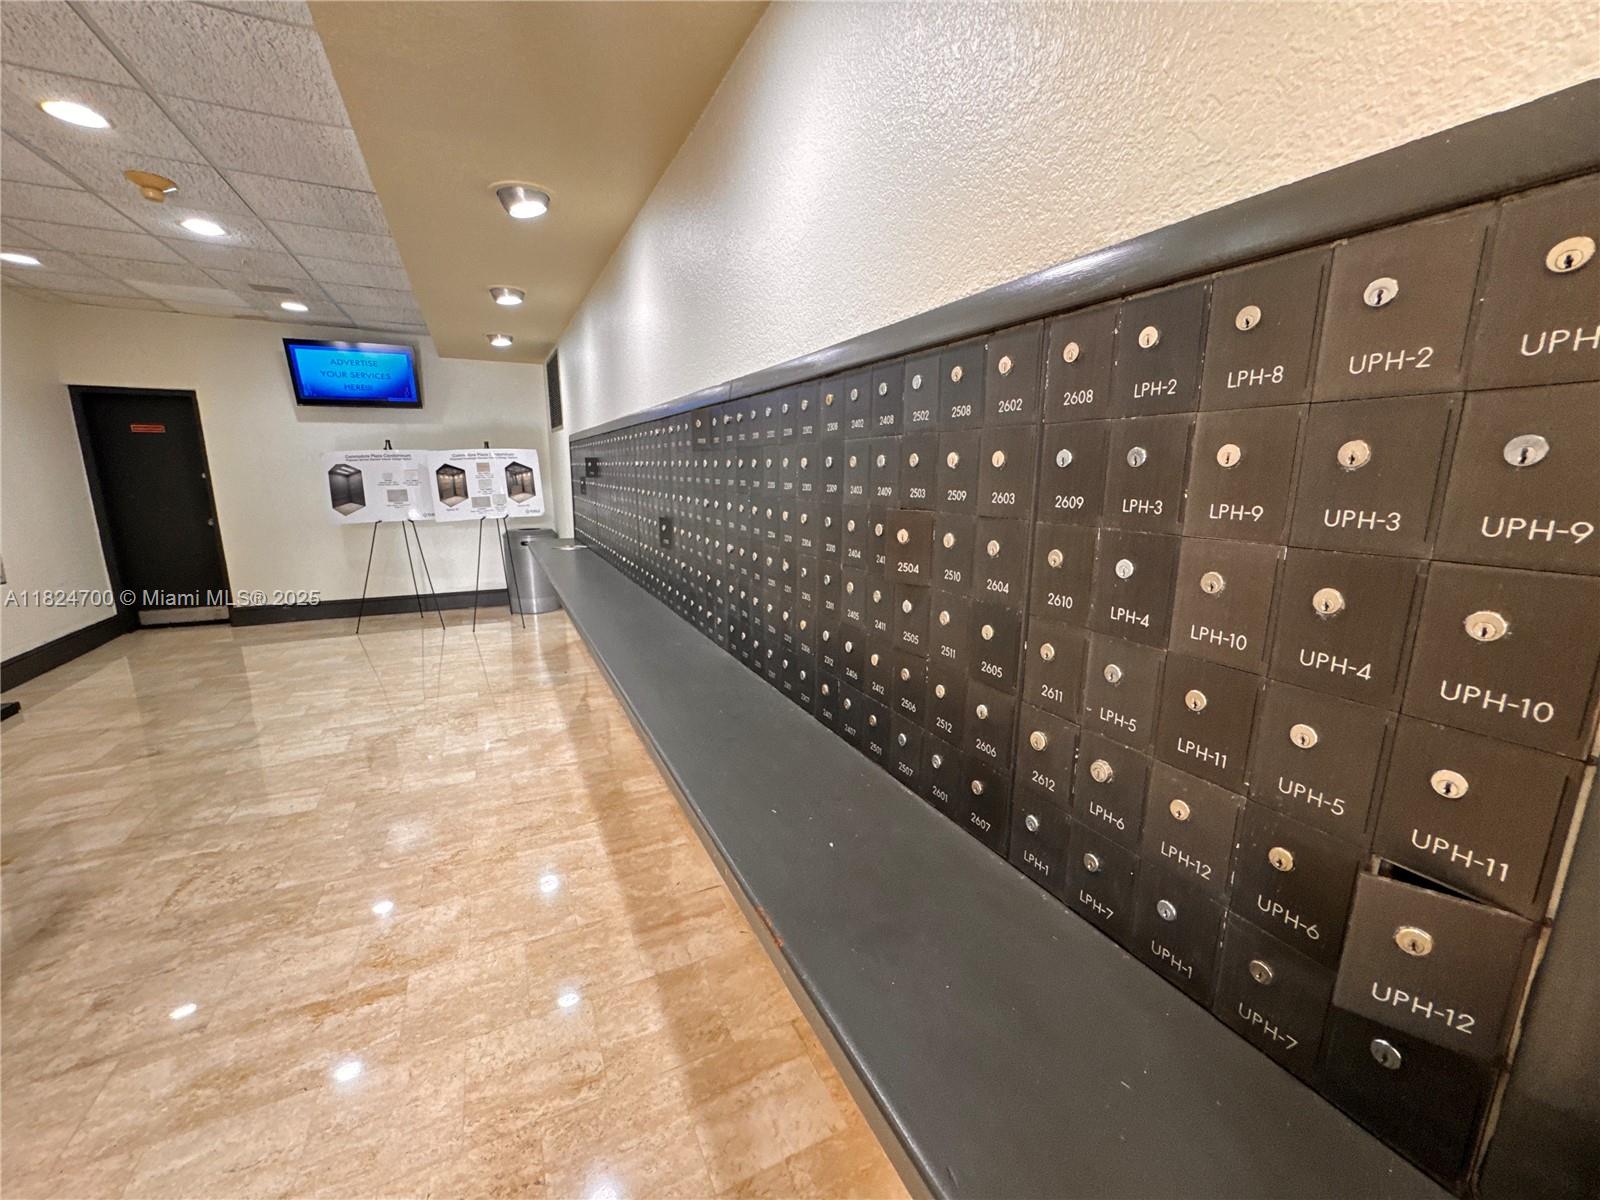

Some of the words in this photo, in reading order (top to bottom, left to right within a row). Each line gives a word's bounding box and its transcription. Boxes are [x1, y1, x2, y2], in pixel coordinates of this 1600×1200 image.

[1521, 325, 1600, 356] UPH
[330, 359, 377, 367] ADVERTISE
[1349, 347, 1433, 374] UPH-2
[320, 370, 347, 378] YOUR
[350, 371, 392, 380] SERVICES
[1228, 366, 1283, 388] LPH-8
[1134, 379, 1177, 398] LPH-2
[1064, 389, 1093, 405] 2608
[952, 405, 971, 417] 2508
[999, 399, 1022, 412] 2602
[880, 415, 894, 425] 2408
[913, 410, 929, 421] 2502
[850, 486, 862, 494] 2403
[877, 487, 892, 496] 2409
[910, 488, 925, 498] 2503
[948, 490, 966, 501] 2509
[992, 492, 1015, 504] 2603
[1055, 496, 1084, 508] 2609
[1123, 499, 1162, 514] LPH-3
[1210, 504, 1263, 521] LPH-9
[1324, 509, 1400, 531] UPH-3
[1482, 516, 1594, 543] UPH-9
[848, 549, 860, 558] 2404
[876, 555, 885, 564] 241
[898, 562, 919, 573] 2504
[944, 569, 961, 582] 2510
[987, 579, 1008, 593] 2604
[1048, 593, 1072, 608] 2610
[848, 609, 859, 620] 2405
[1111, 606, 1149, 627] LPH-4
[875, 620, 886, 630] 2411
[903, 631, 918, 644] 2505
[1191, 625, 1247, 650] LPH-10
[941, 645, 955, 658] 2511
[981, 661, 1002, 677] 2605
[1300, 649, 1371, 680] UPH-4
[872, 682, 884, 694] 2412
[1041, 685, 1062, 702] 2611
[901, 698, 916, 712] 2506
[1441, 680, 1553, 722] UPH-10
[936, 717, 952, 733] 2512
[1100, 708, 1136, 732] LPH-5
[870, 742, 882, 755] 2501
[976, 739, 996, 757] 2606
[1178, 738, 1226, 768] LPH-11
[899, 762, 913, 776] 2507
[1032, 771, 1055, 792] 2612
[933, 786, 948, 802] 2601
[1279, 777, 1344, 815] UPH-5
[971, 813, 990, 831] 2607
[1090, 802, 1124, 830] LPH-6
[1023, 849, 1049, 877] LPH-1
[1161, 841, 1211, 880] LPH-12
[1412, 829, 1508, 881] UPH-11
[1079, 889, 1114, 920] LPH-7
[1258, 894, 1319, 939] UPH-6
[1150, 939, 1193, 980] UPH-1
[1372, 982, 1475, 1033] UPH-12
[1238, 1001, 1299, 1052] UPH-7
